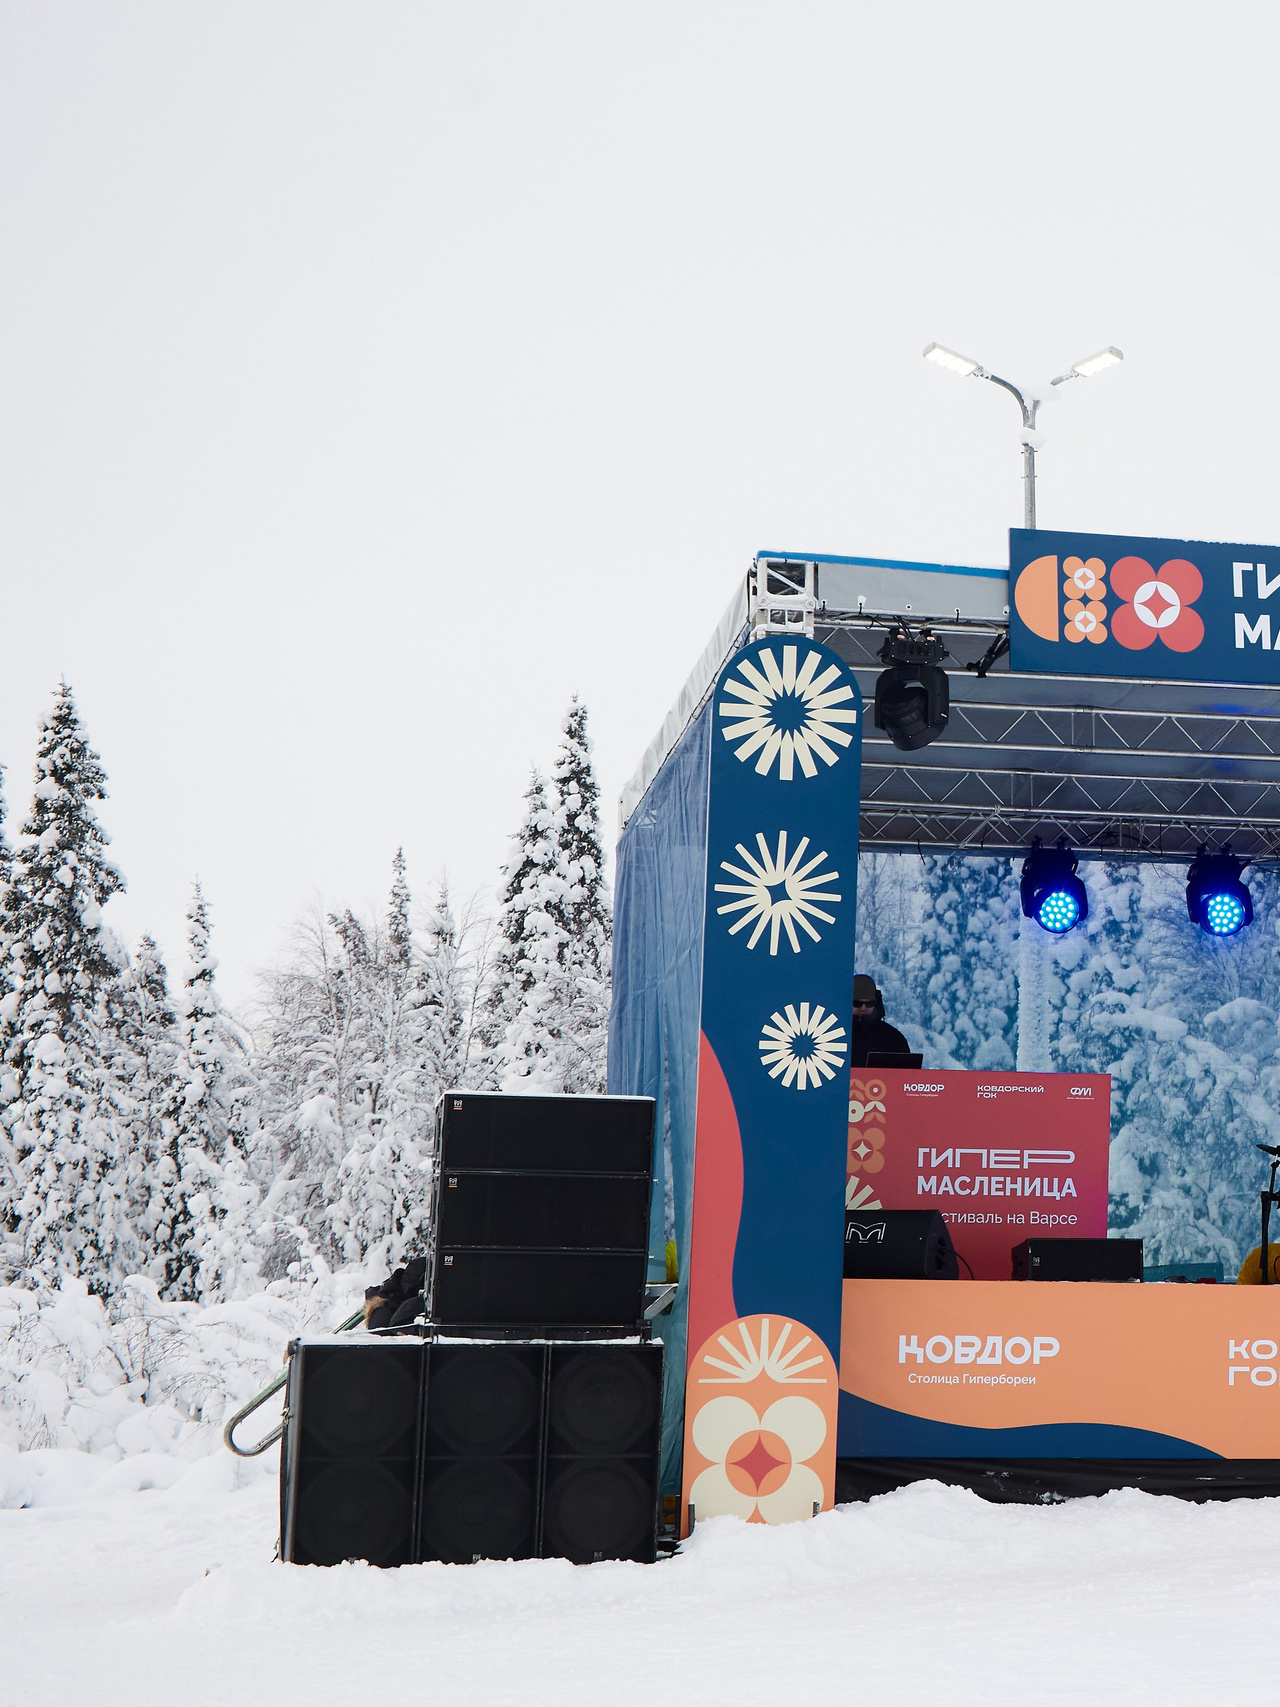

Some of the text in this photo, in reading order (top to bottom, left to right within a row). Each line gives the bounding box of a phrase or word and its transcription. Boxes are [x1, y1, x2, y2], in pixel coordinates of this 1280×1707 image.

[903, 1083, 945, 1093] КОВДОР
[977, 1085, 1044, 1093] КОВДОРСКИЙ
[917, 1147, 1076, 1170] ГИПЕР
[917, 1175, 1078, 1200] МАСЛЕНИЦА
[941, 1211, 1078, 1228] стиваль на Варсе
[898, 1334, 1061, 1365] КОВДОР
[907, 1372, 1037, 1387] Столица Гипербореи
